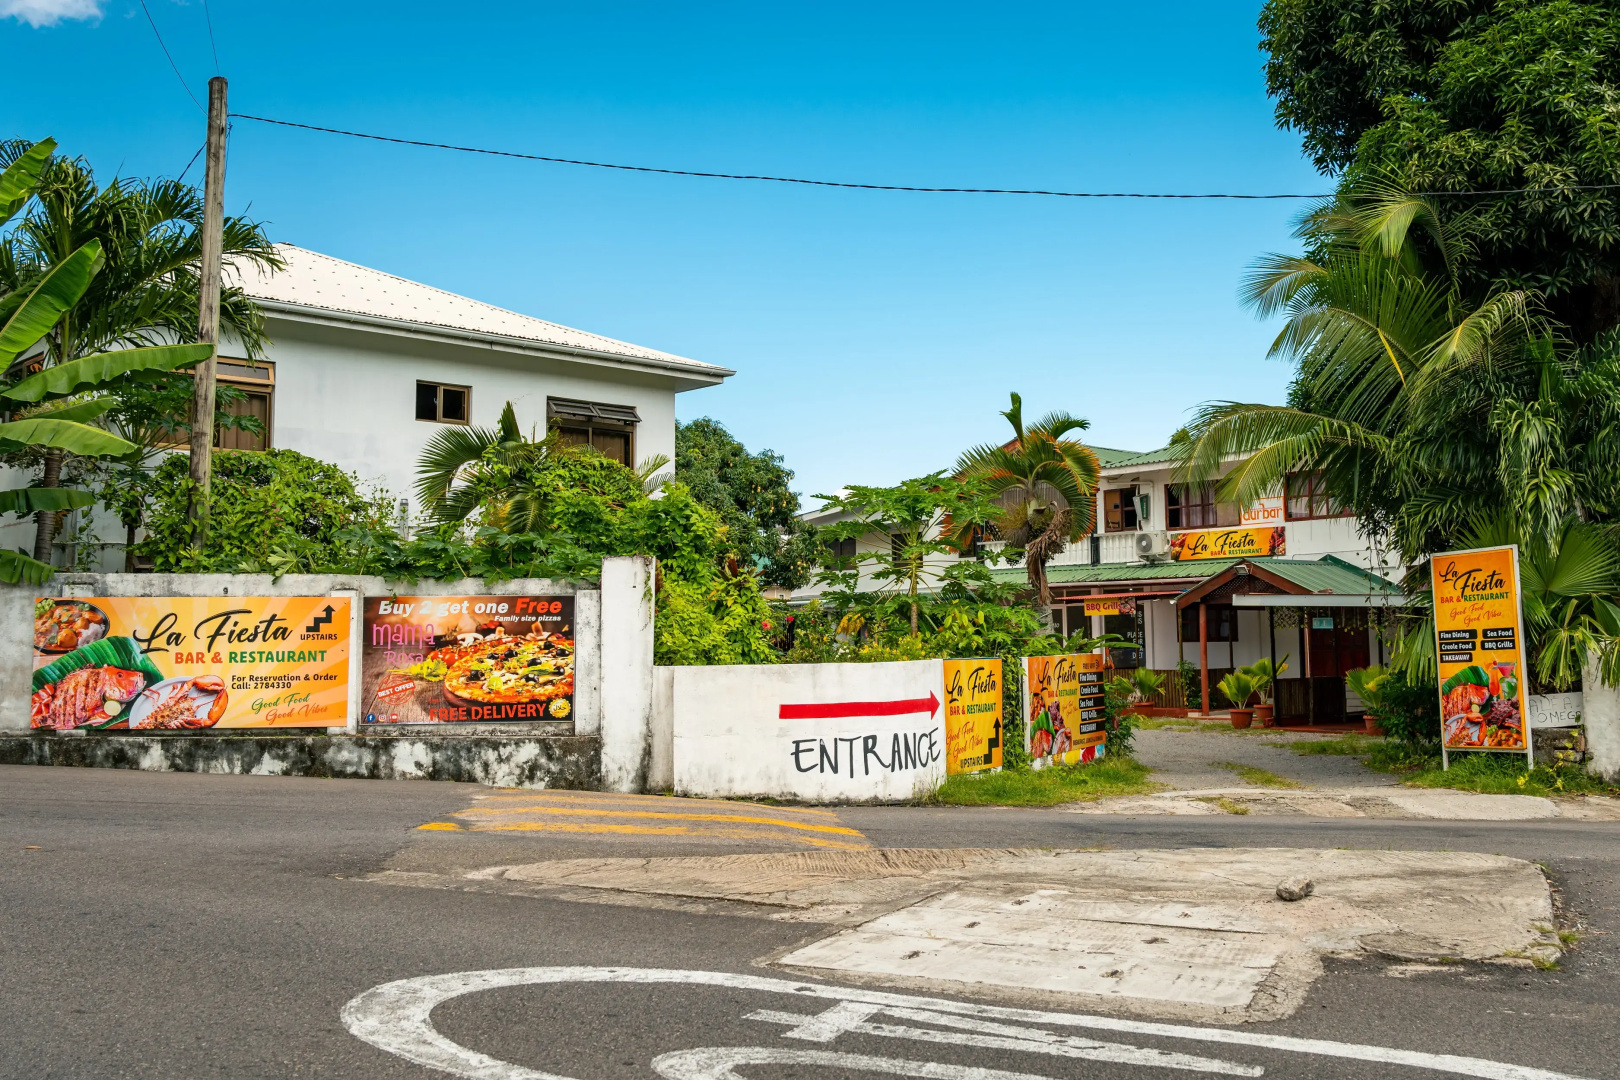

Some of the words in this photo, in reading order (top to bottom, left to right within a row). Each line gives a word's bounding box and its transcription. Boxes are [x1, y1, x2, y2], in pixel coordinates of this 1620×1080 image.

[1187, 534, 1209, 556] La
[1214, 531, 1257, 554] Fiesta
[1439, 562, 1459, 583] La
[1453, 568, 1506, 600] Fiesta
[1464, 592, 1510, 603] RESTAURANT
[378, 600, 414, 617] Buy
[419, 600, 433, 614] 2
[436, 600, 469, 618] get
[474, 602, 509, 614] one
[515, 598, 562, 614] Free
[1086, 602, 1101, 612] BBQ
[1103, 602, 1122, 610] Grills
[1450, 608, 1466, 620] Good
[1468, 602, 1484, 613] Food
[1464, 614, 1480, 627] Good
[1484, 610, 1502, 620] Vibes
[132, 612, 186, 654] La
[194, 608, 293, 653] Fiesta
[174, 651, 206, 664] BAR
[210, 651, 223, 664] &
[229, 650, 328, 663] RESTAURANT
[384, 650, 424, 666] Rosa
[231, 674, 246, 682] For
[249, 674, 302, 682] Reservation
[304, 674, 310, 682] &
[313, 673, 338, 681] Order
[1038, 661, 1053, 692] La
[1054, 658, 1077, 690] Fiesta
[1087, 673, 1097, 682] Dining
[254, 682, 292, 690] 2784330
[378, 688, 394, 698] BEST
[394, 682, 414, 692] OFFER
[946, 670, 964, 704] La
[968, 666, 997, 701] Fiesta
[252, 698, 280, 714] Good
[284, 693, 312, 706] Food
[950, 706, 960, 716] BAR
[961, 705, 966, 714] &
[967, 702, 997, 714] RESTAURANT
[1086, 697, 1094, 706] Food
[264, 709, 294, 725] Good
[298, 704, 328, 718] Vibes
[429, 706, 468, 721] FREE
[472, 703, 546, 720] DELIVERY
[946, 729, 959, 746] Good
[962, 721, 975, 738] Food
[791, 727, 942, 779] ENTRANCE
[953, 741, 967, 762] Good
[960, 756, 983, 768] UPSTAIRS
